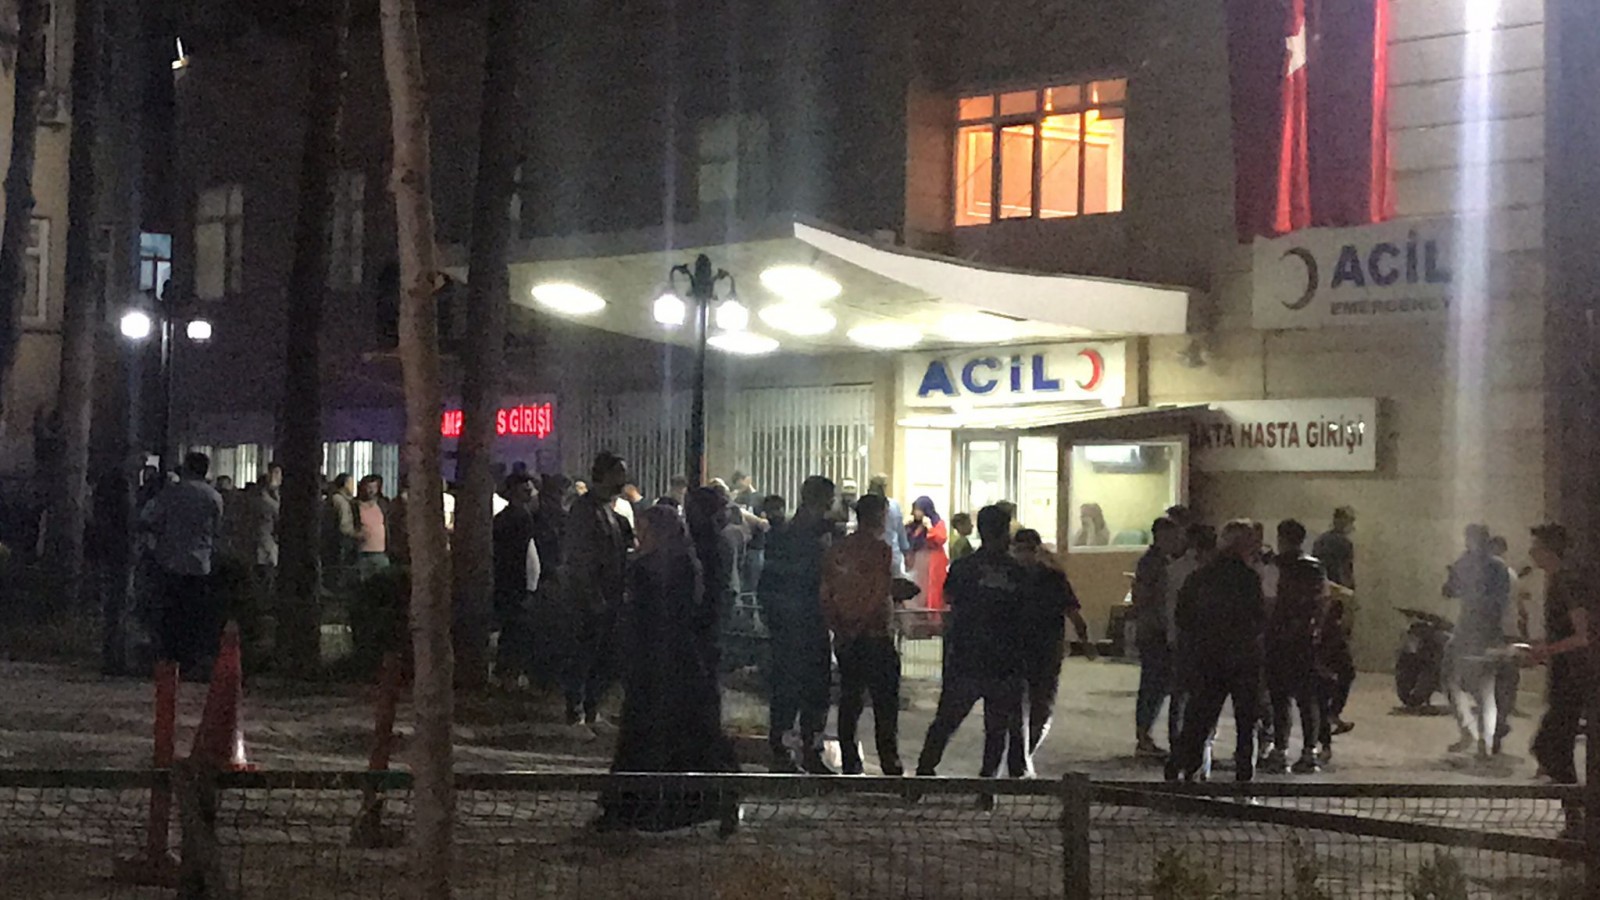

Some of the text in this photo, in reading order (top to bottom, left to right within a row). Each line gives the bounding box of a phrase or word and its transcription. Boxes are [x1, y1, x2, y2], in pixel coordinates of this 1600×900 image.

[1331, 229, 1453, 288] ACİL
[917, 354, 1061, 398] ACİL
[509, 402, 552, 439] GİRİŞİ
[1240, 421, 1300, 448] HASTA
[1306, 414, 1365, 454] GİRİŞİ
